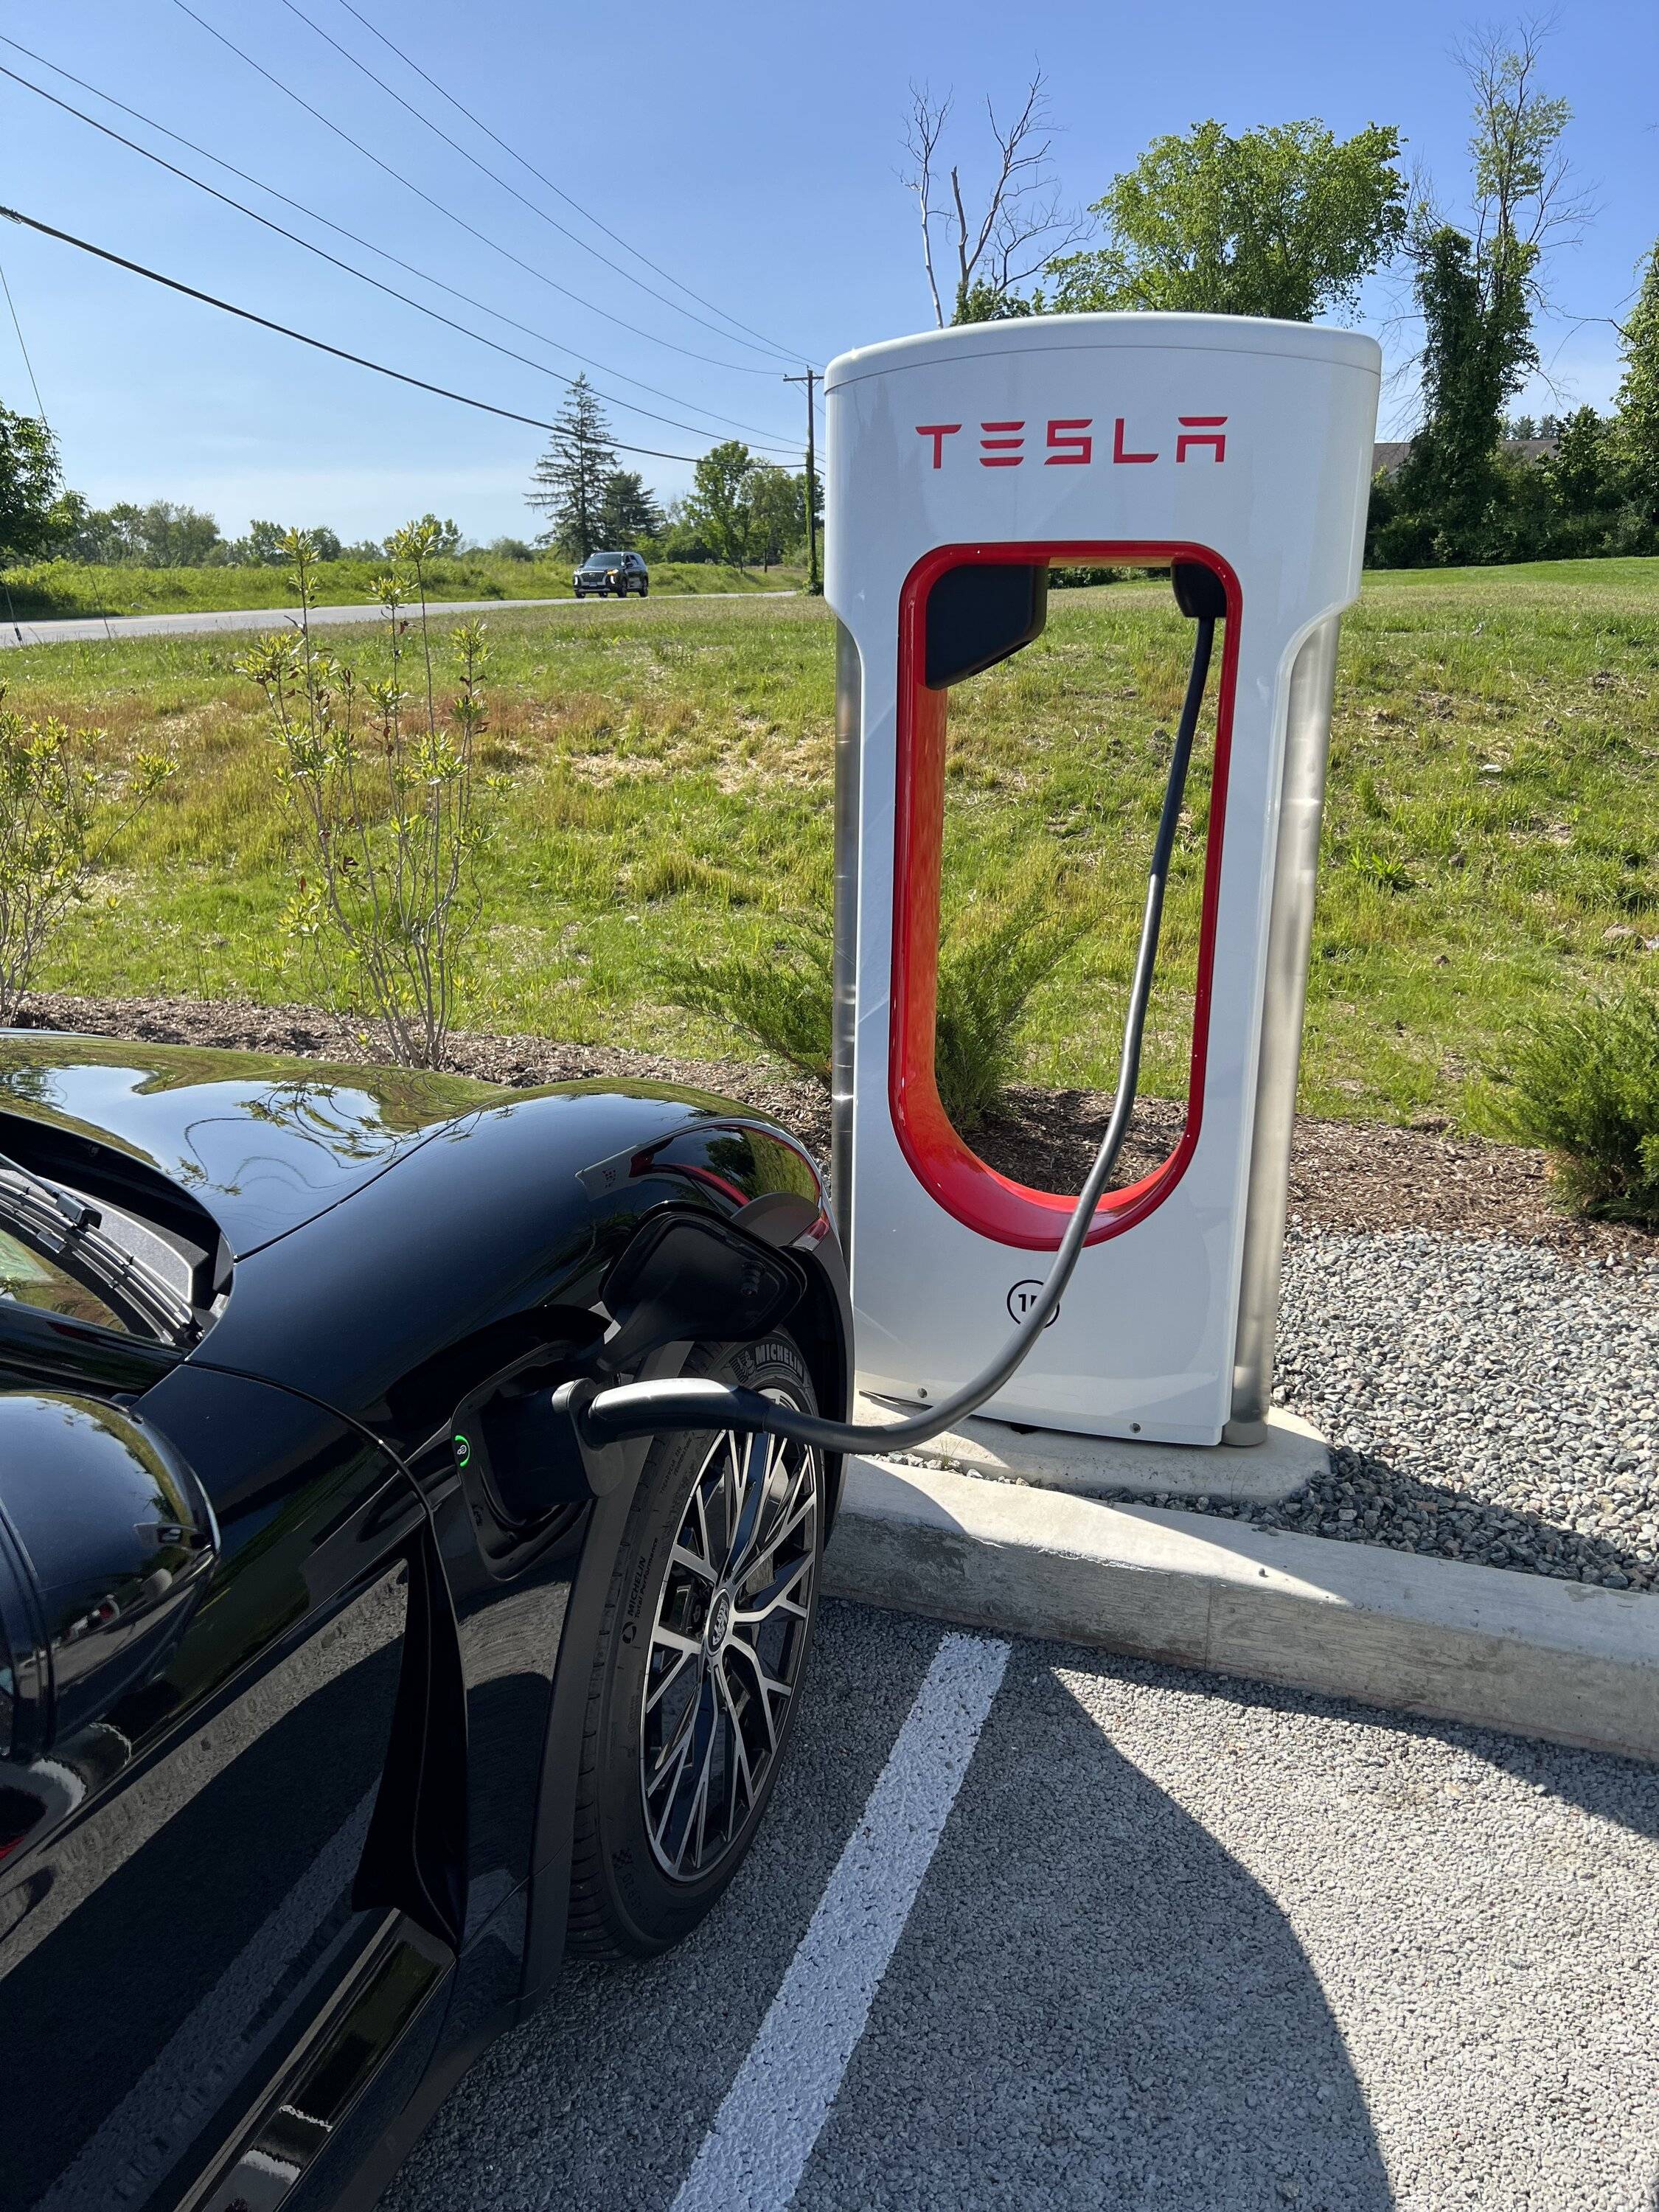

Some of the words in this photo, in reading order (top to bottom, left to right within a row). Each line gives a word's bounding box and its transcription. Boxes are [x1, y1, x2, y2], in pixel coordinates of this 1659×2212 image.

[916, 417, 1228, 469] TESLA
[755, 1343, 803, 1379] MICHELIN
[627, 1556, 646, 1617] MICHELIN
[635, 1596, 644, 1618] Total
